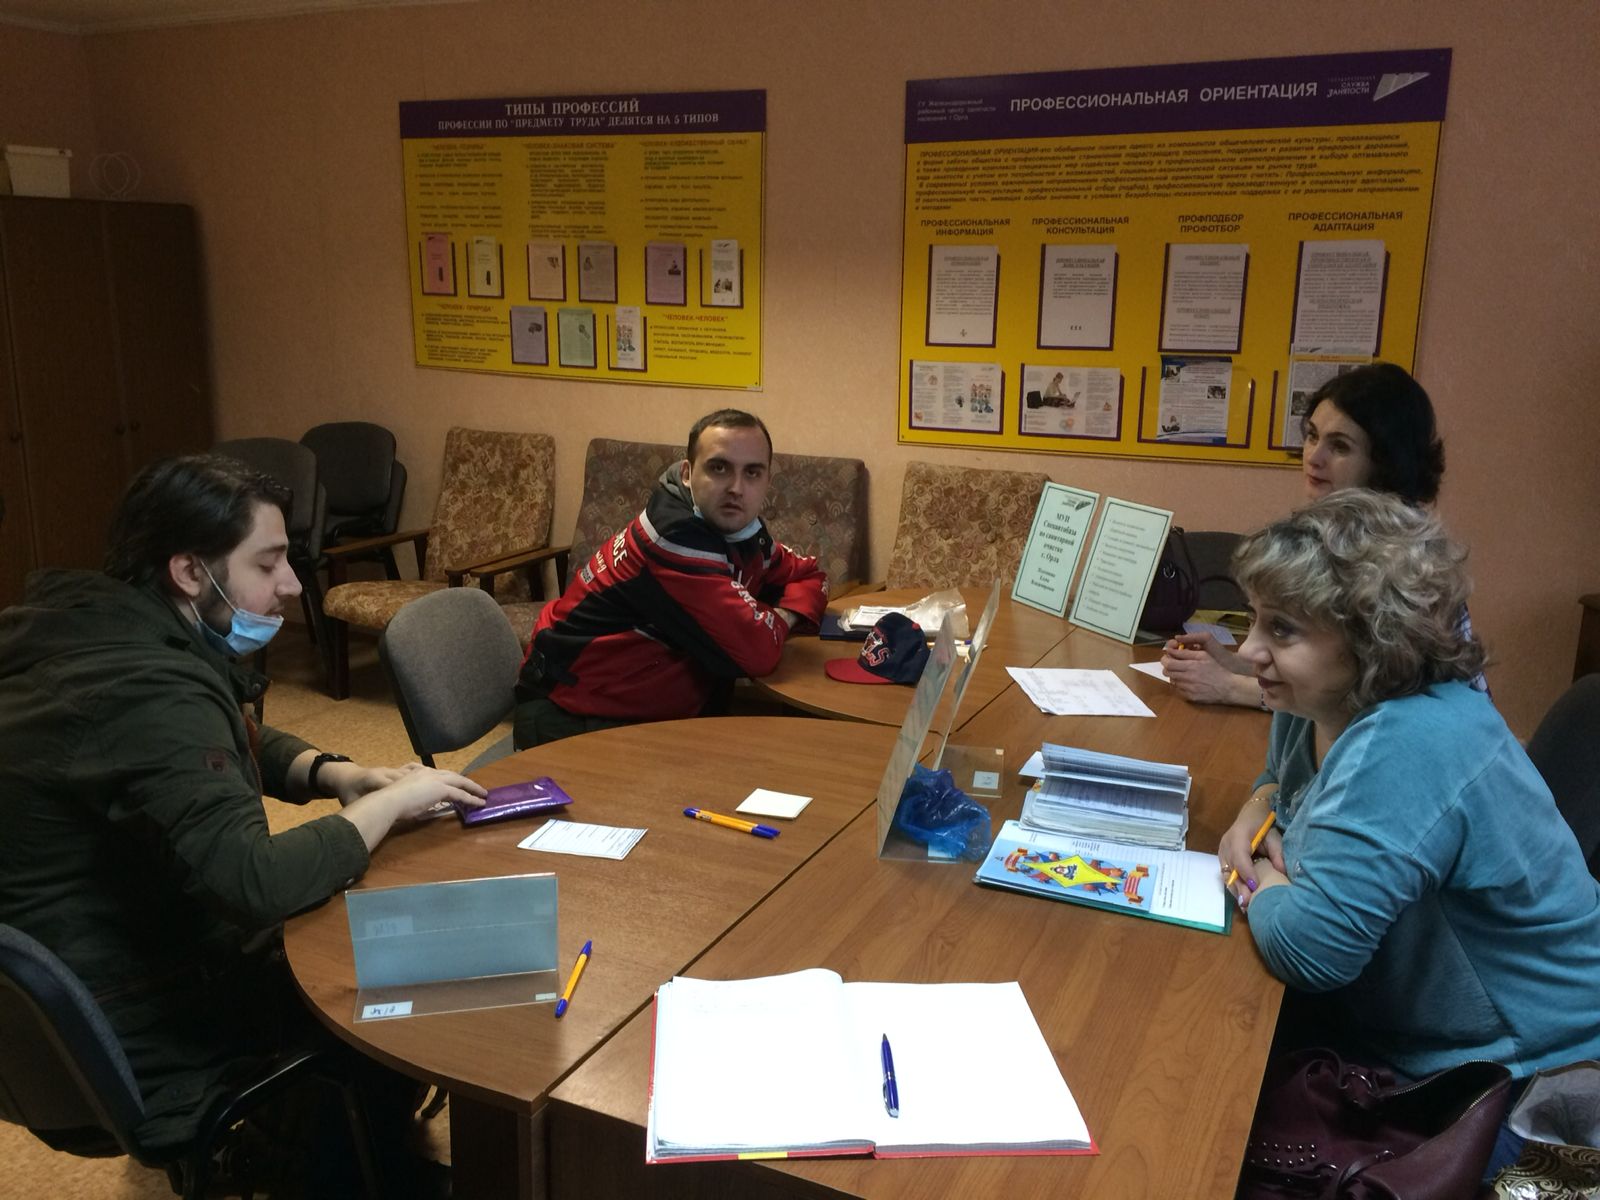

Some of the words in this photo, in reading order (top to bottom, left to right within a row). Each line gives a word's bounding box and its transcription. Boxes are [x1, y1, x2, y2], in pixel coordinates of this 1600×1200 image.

[1010, 89, 1188, 112] ПРОФЕССИОНАЛЬНАЯ
[1199, 82, 1317, 103] ОРИЕНТАЦИЯ
[505, 103, 545, 116] ТИПЫ
[552, 98, 640, 114] ПРОФЕССИЙ
[438, 120, 492, 130] ПРОФЕССИИ
[495, 118, 508, 129] ПО
[608, 115, 653, 127] ДЕЛЯТСЯ
[656, 114, 671, 125] НА
[674, 114, 680, 125] 5
[684, 113, 719, 124] ТИПОВ
[1032, 216, 1130, 226] ПРОФЕССИОНАЛЬНАЯ
[1178, 214, 1244, 224] ПРОФПОДБОР
[1288, 211, 1403, 222] ПРОФЕССИОНАЛЬНАЯ
[920, 218, 1010, 227] ПРОФЕССИОНАЛЬНАЯ
[1314, 222, 1375, 232] АДАПТАЦИЯ
[936, 227, 994, 236] ИНФОРМАЦИЯ
[1046, 226, 1115, 235] КОНСУЛЬТАЦИЯ
[1180, 224, 1240, 233] ПРОФОТБОР
